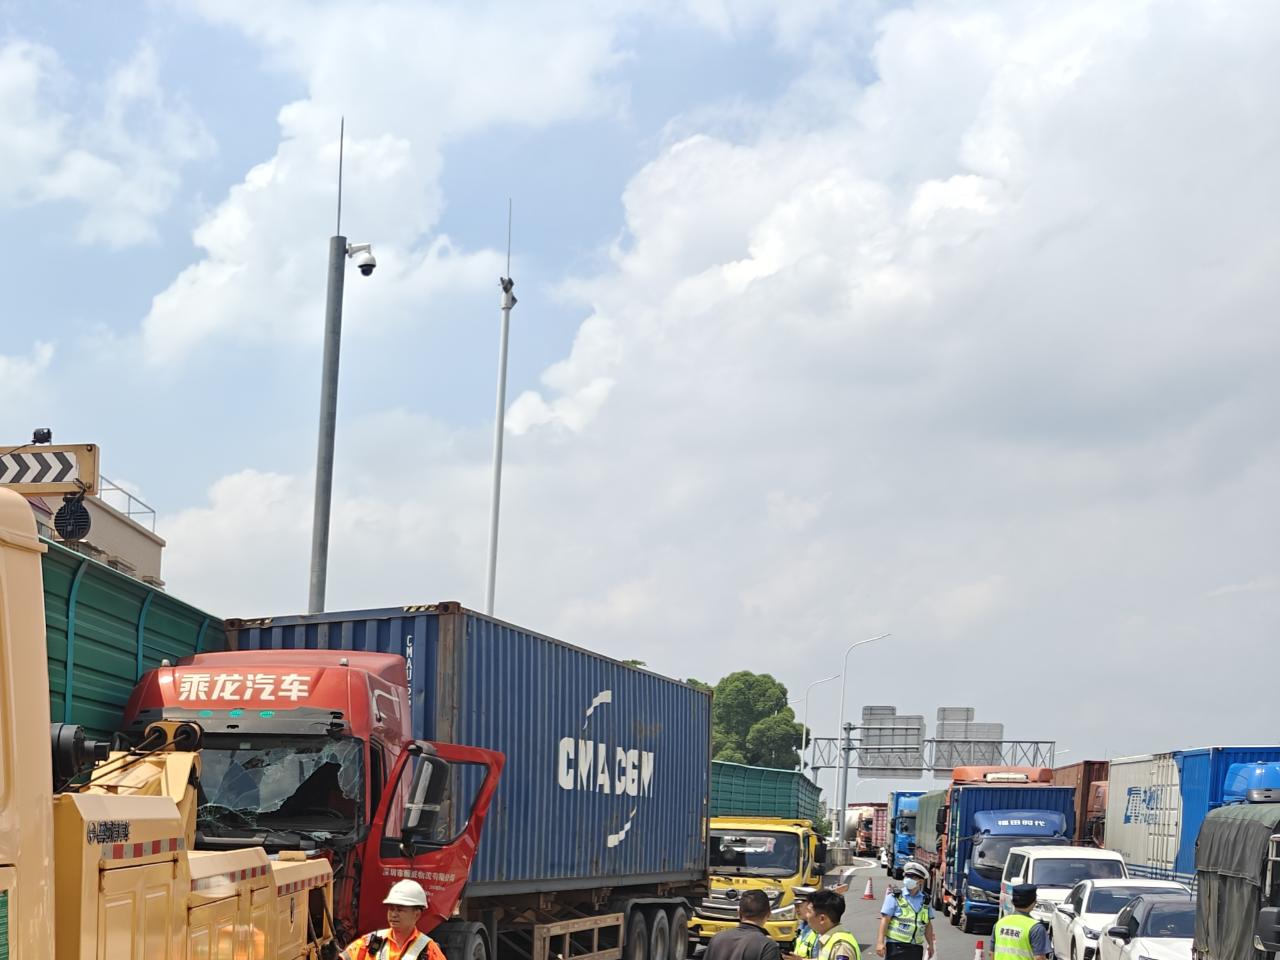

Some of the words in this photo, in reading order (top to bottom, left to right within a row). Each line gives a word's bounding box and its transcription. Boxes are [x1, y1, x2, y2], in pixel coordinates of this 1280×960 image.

[179, 673, 311, 701] 乘龙汽车
[558, 736, 611, 794] CMA
[615, 746, 655, 798] CGM
